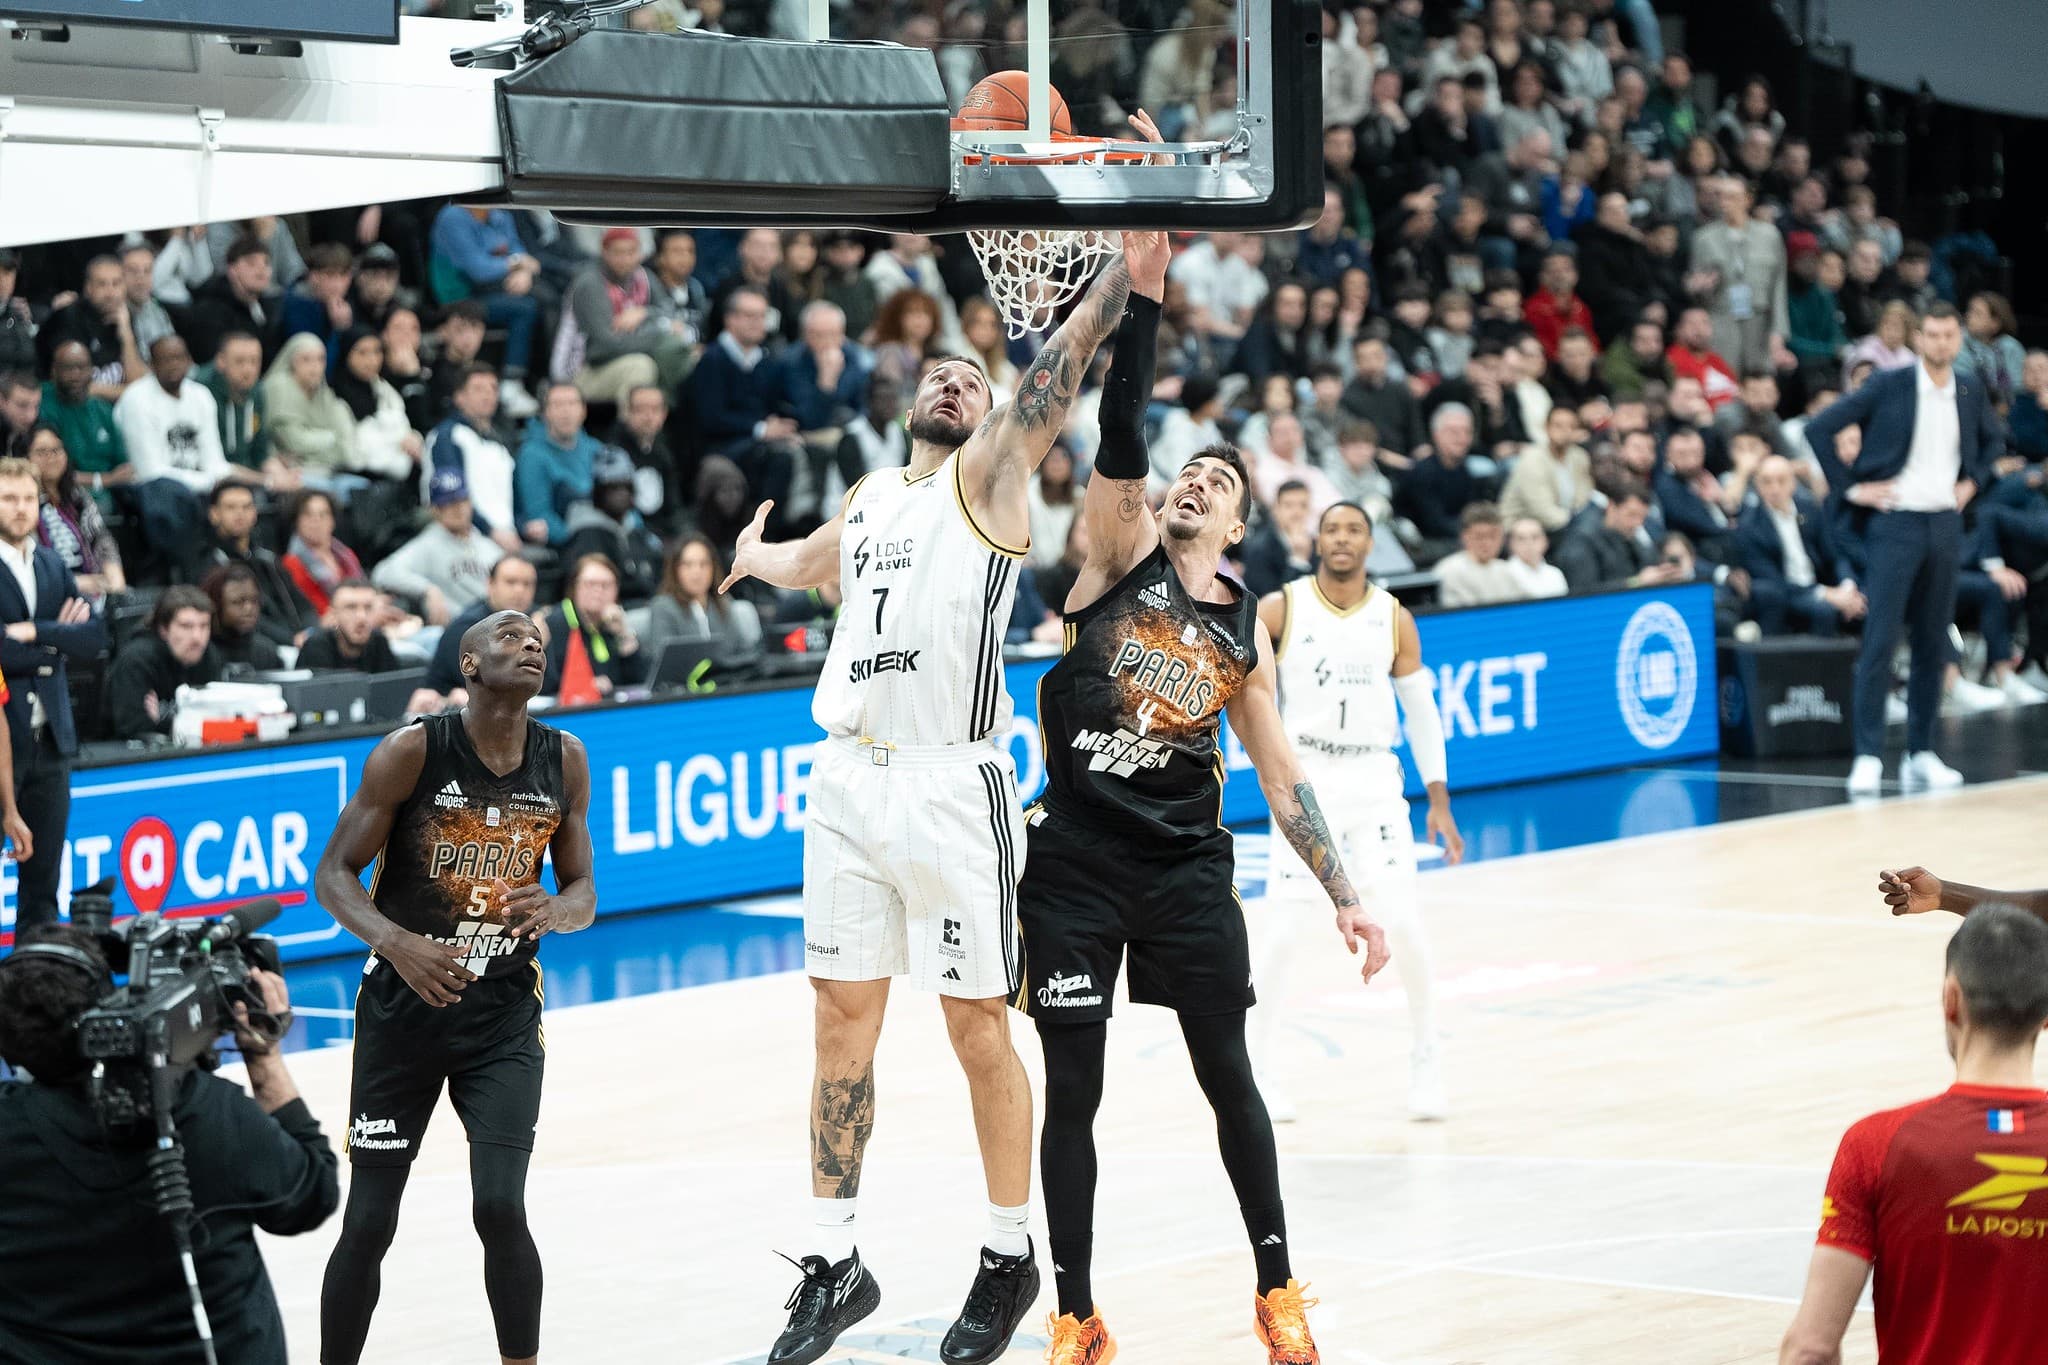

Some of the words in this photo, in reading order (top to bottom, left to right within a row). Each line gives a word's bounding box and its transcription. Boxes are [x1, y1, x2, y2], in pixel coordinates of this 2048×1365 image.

[876, 538, 914, 557] LDLC
[875, 556, 912, 572] ASVEL
[872, 587, 890, 635] 7
[1138, 588, 1166, 611] snipes
[850, 650, 921, 684] SKEEK
[1107, 638, 1214, 720] PARIS
[1408, 652, 1548, 746] KET
[1136, 698, 1158, 737] 4
[1339, 699, 1346, 730] 1
[1071, 729, 1174, 770] MENNEN
[434, 793, 464, 809] snipes
[508, 803, 554, 814] COURTYARD
[611, 742, 816, 855] LIGUE
[0, 835, 112, 926] ET
[129, 834, 165, 890] a
[182, 810, 309, 900] CAR
[429, 841, 534, 880] PARIS
[466, 886, 491, 917] 5
[424, 933, 520, 958] NNEN
[805, 941, 840, 956] déquat
[1048, 973, 1092, 993] PIZZA
[1037, 987, 1103, 1007] Delamama
[349, 1126, 410, 1150] Delamama
[355, 1118, 397, 1135] PIZZA
[1946, 1215, 1980, 1234] LA
[1984, 1216, 2048, 1238] POST
